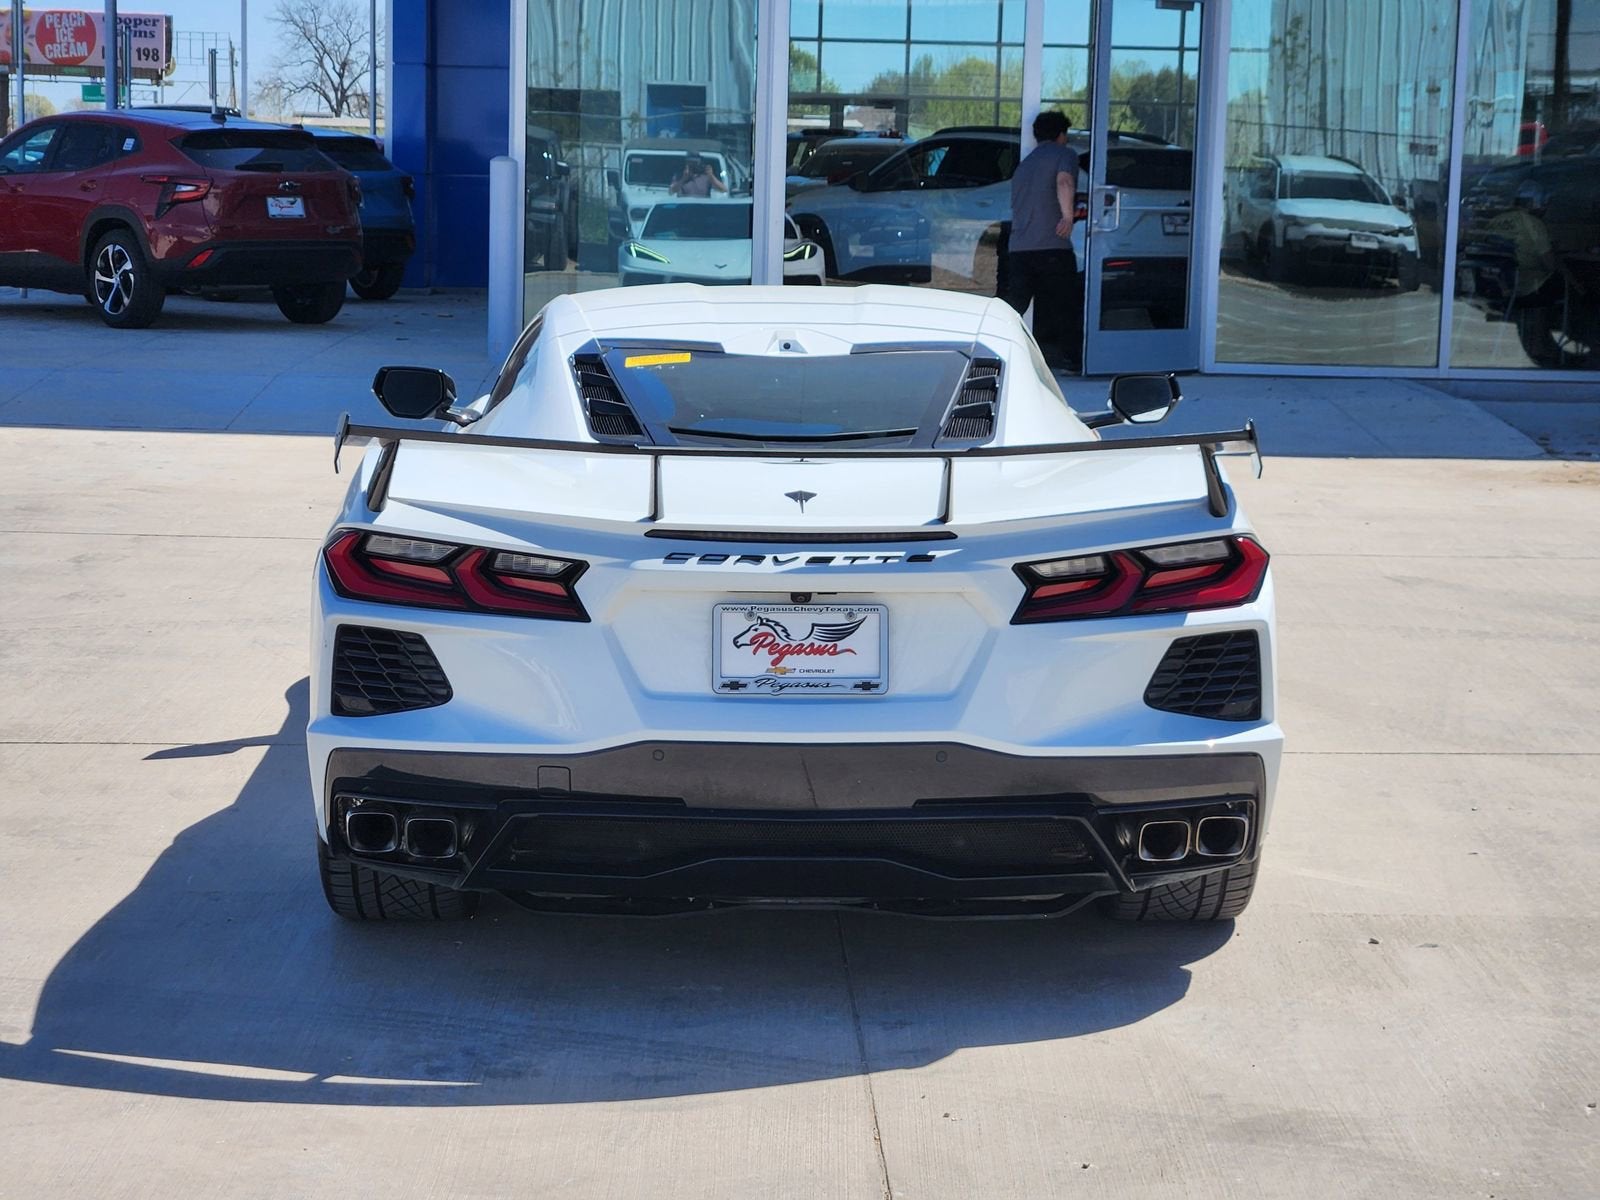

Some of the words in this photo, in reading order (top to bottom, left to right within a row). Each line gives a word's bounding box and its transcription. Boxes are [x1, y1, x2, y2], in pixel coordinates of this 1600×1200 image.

[45, 12, 86, 29] PEACH
[102, 16, 160, 28] ooper
[56, 28, 75, 43] ICE
[45, 41, 88, 59] CREAM
[135, 47, 160, 62] 198
[663, 551, 936, 566] CORVETTE
[750, 632, 857, 667] Pegasus
[754, 678, 847, 693] Pegasus
